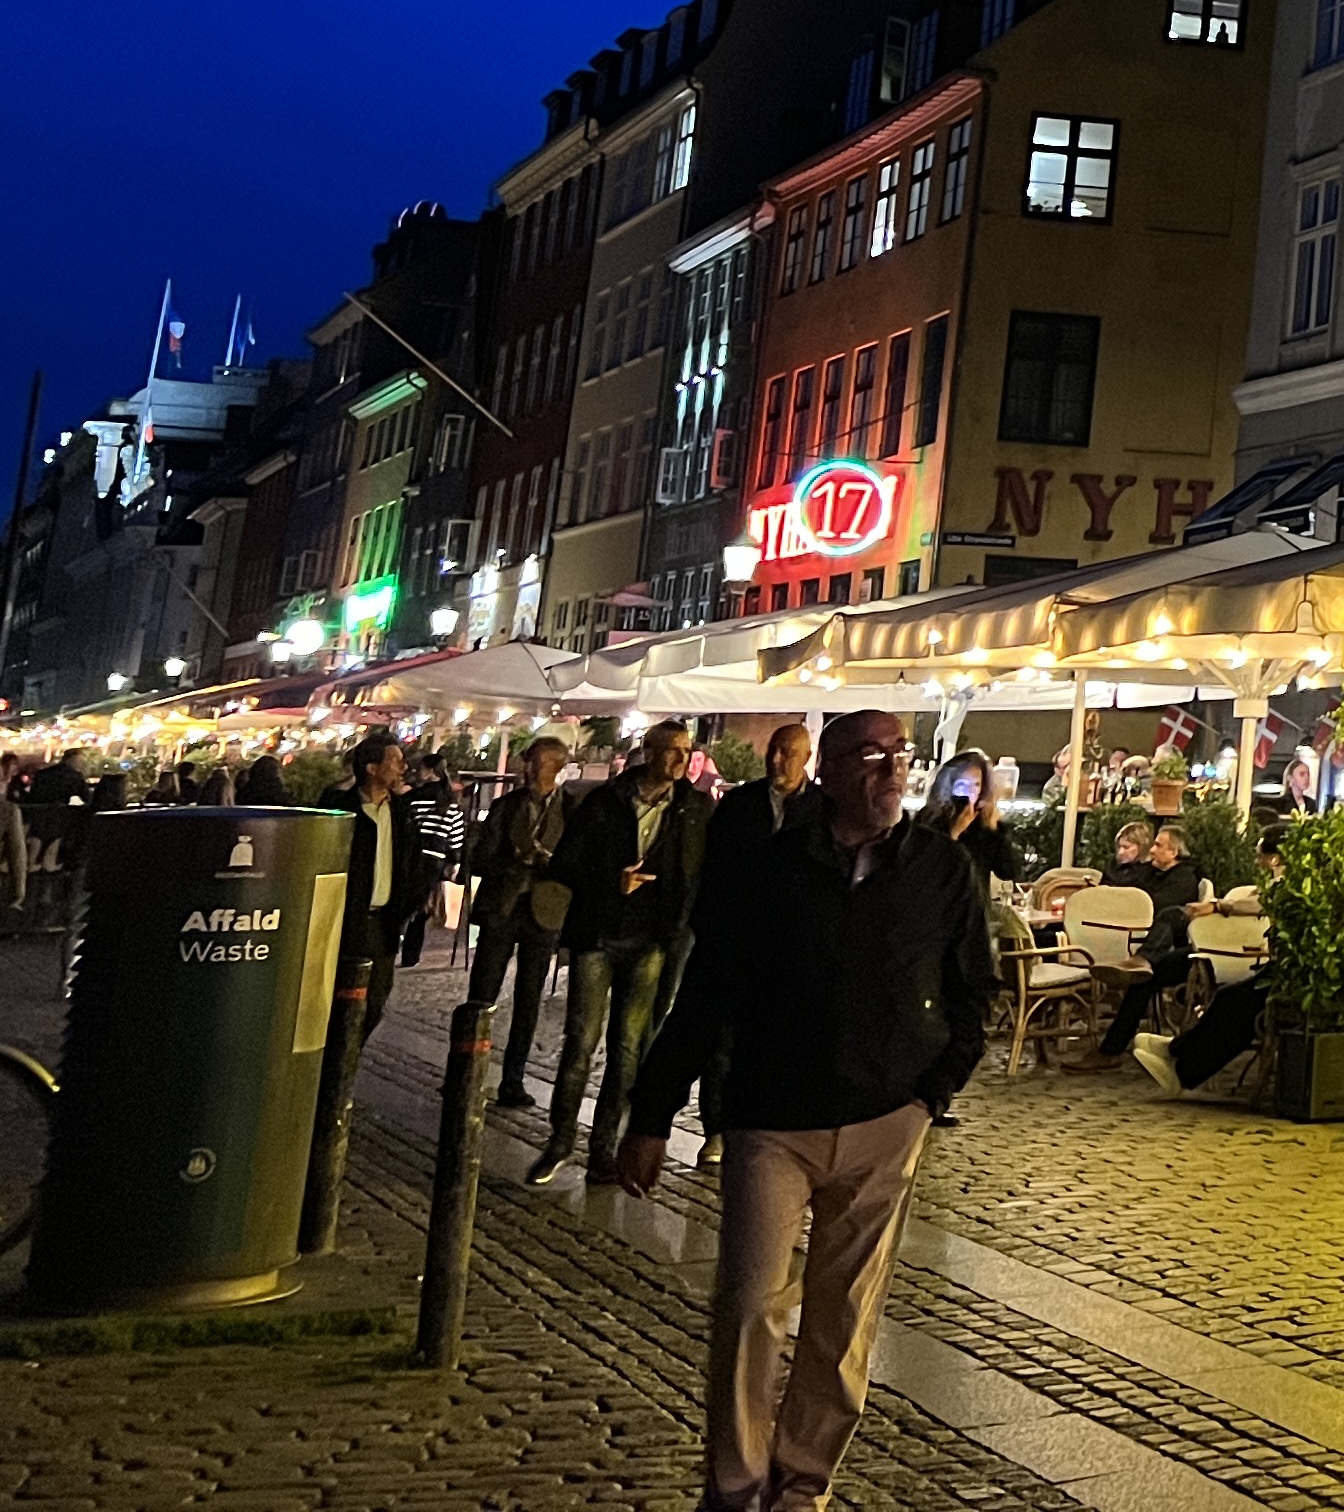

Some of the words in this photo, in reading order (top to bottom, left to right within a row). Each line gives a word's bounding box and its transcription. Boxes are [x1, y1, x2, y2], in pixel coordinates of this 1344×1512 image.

[812, 481, 872, 539] 17
[181, 909, 281, 933] Affald
[180, 939, 270, 963] Waste
